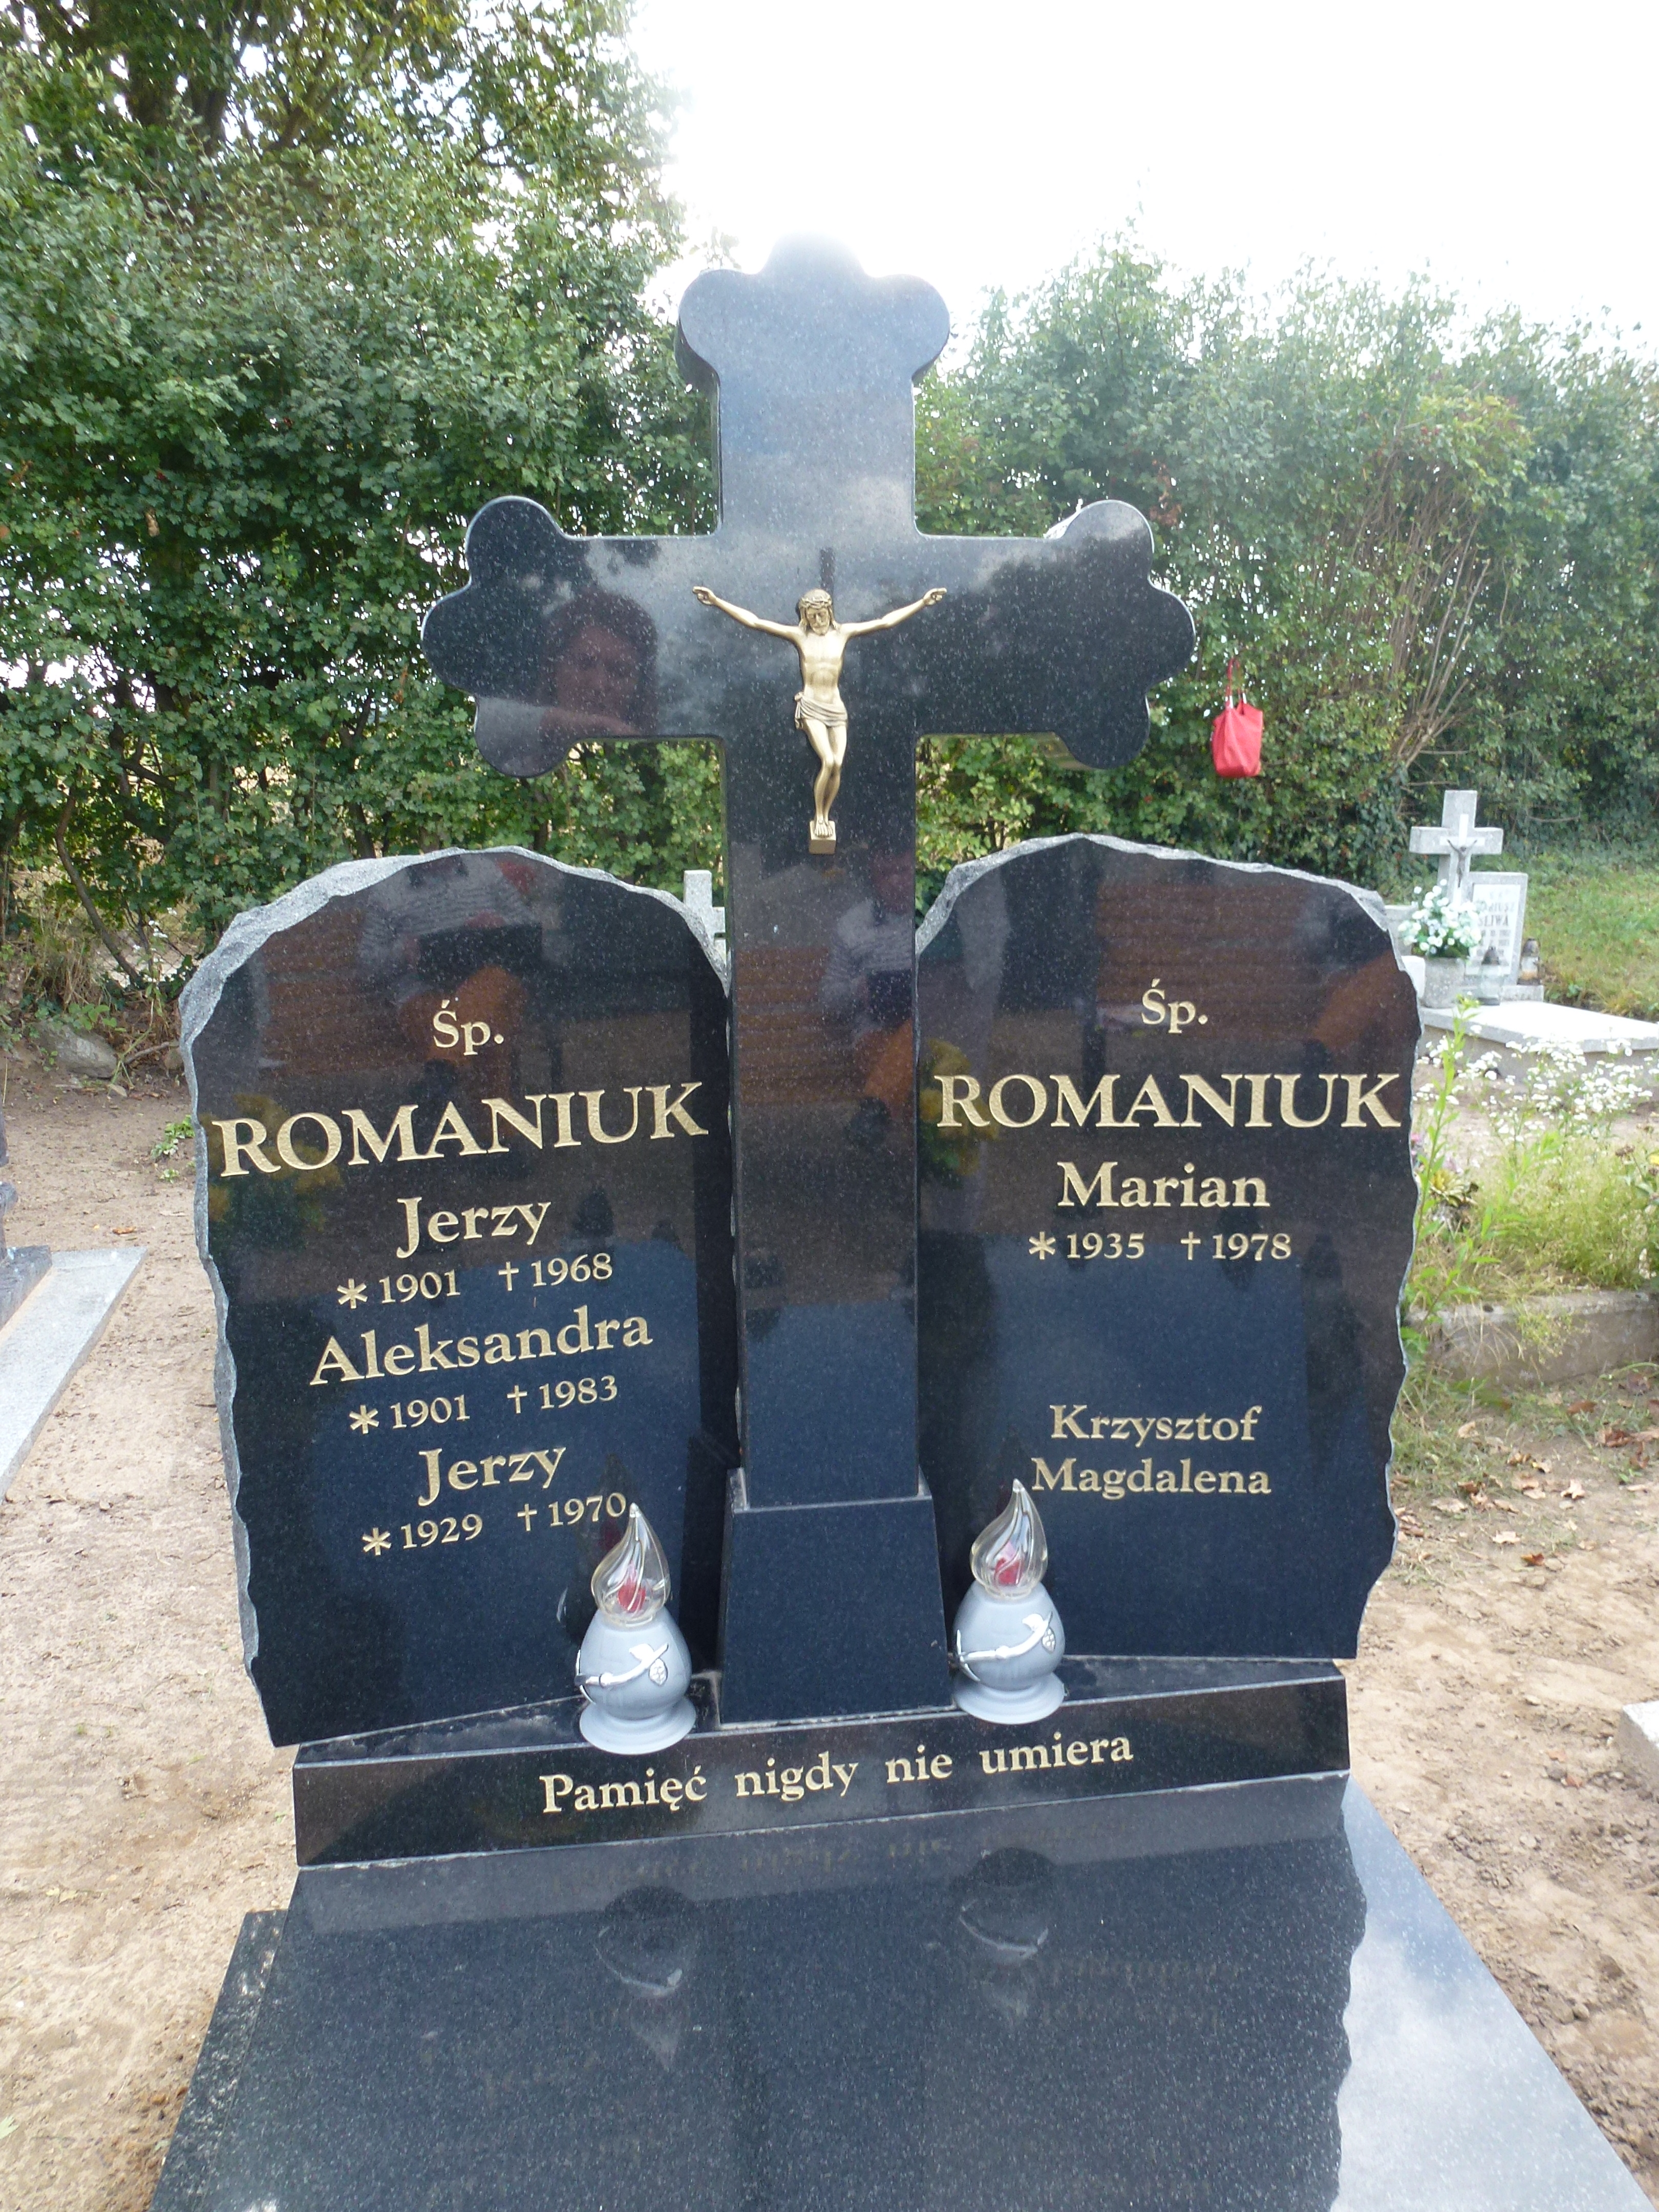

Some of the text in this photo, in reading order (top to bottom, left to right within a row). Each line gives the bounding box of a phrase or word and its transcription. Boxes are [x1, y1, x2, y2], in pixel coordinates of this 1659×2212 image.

[432, 999, 505, 1056] Śp.
[1140, 979, 1209, 1034] Śp.
[933, 1072, 1402, 1129] ROMANIUK
[210, 1081, 709, 1178] ROMANIUK
[1056, 1161, 1271, 1208] Marian
[395, 1196, 552, 1259] Jerzy
[1066, 1231, 1292, 1263] 1935 1978
[378, 1253, 613, 1305] 1901 1968
[309, 1304, 654, 1386] Aleksandra
[390, 1375, 618, 1430] 1901 1983
[1049, 1404, 1263, 1448] Krzysztof
[417, 1447, 566, 1506] Jerzy
[1030, 1457, 1272, 1500] Magdalena
[400, 1492, 627, 1550] 1929 1970
[538, 1732, 1135, 1814] Pamięć nigdy nie umiera
